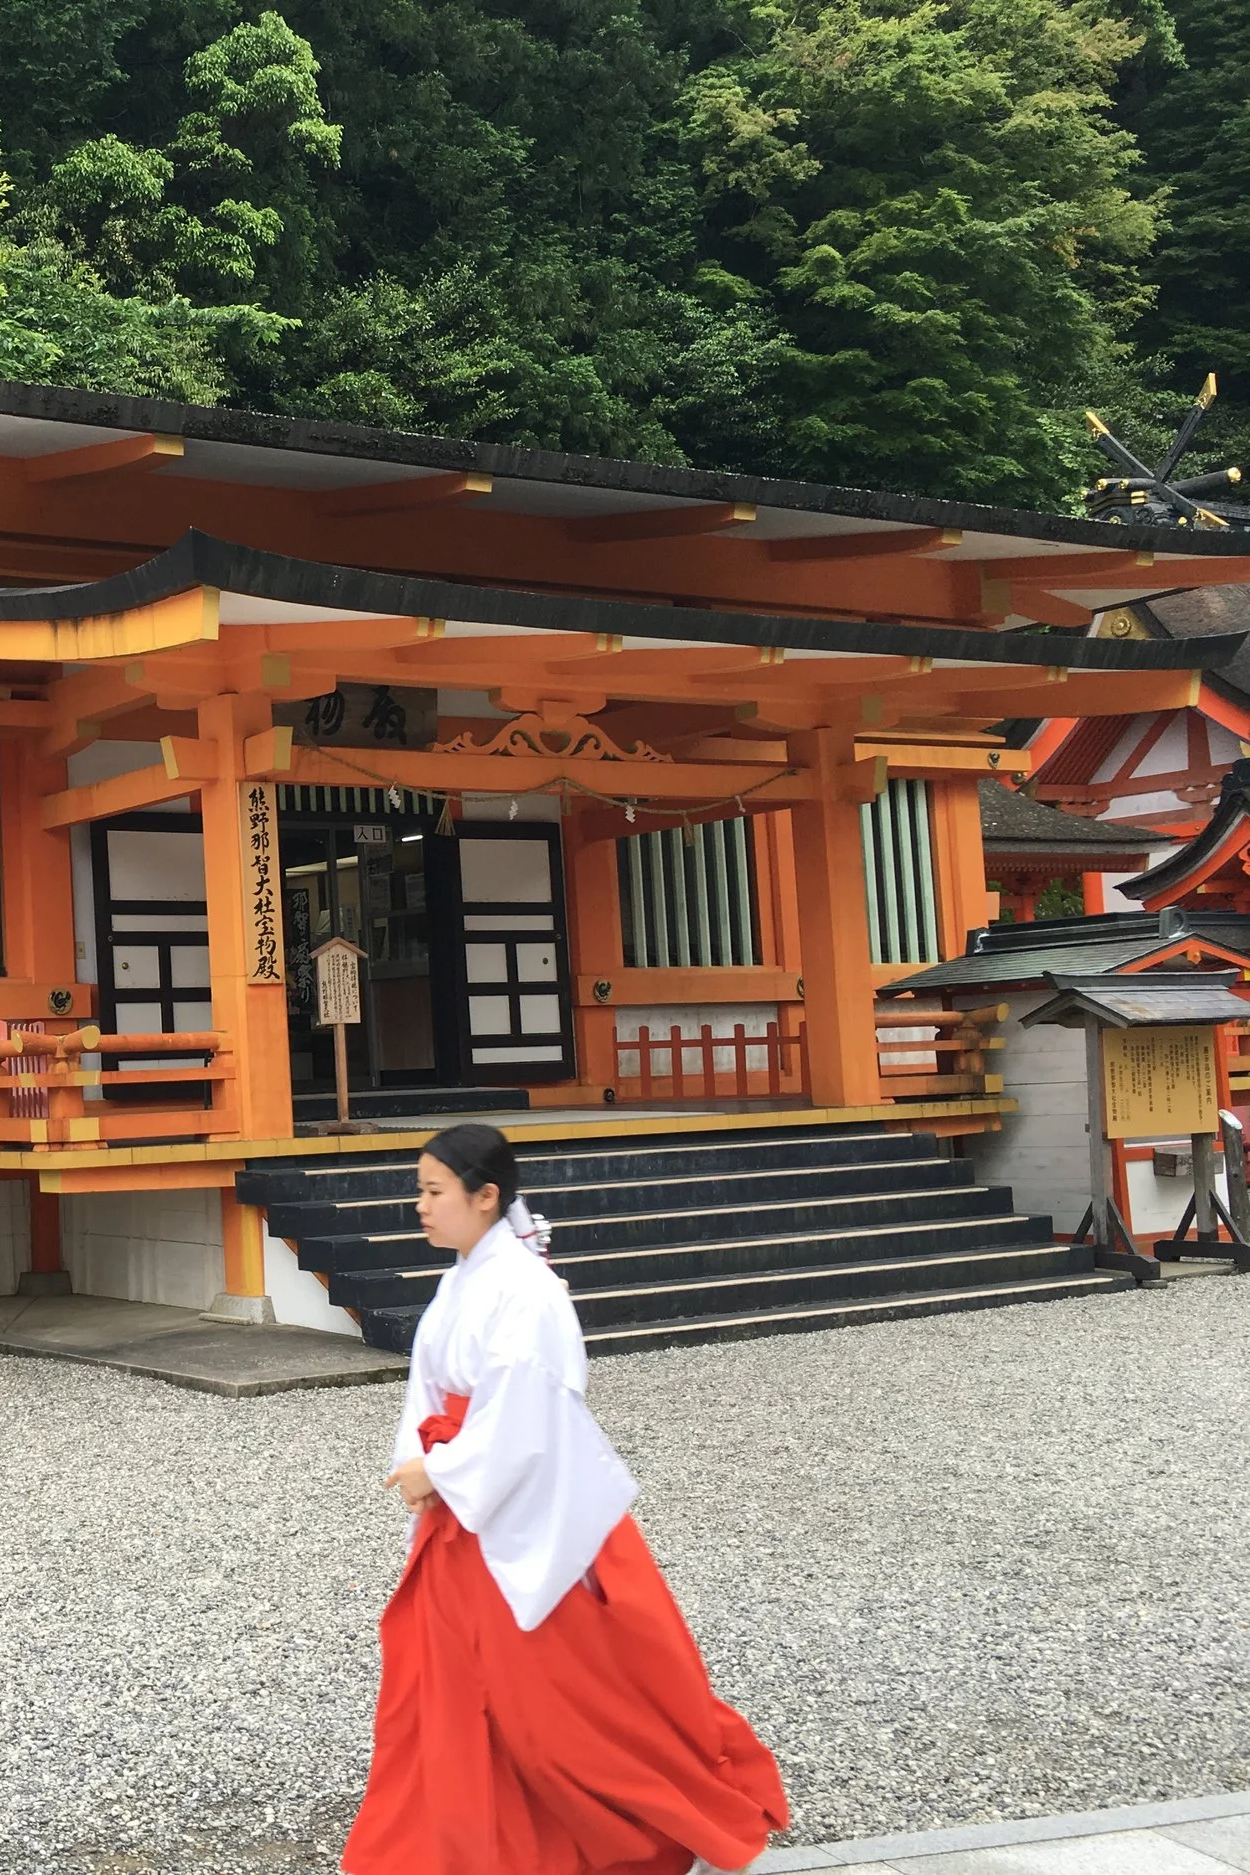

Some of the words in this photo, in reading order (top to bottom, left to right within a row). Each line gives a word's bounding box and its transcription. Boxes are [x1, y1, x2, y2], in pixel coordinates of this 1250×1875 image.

[248, 786, 281, 980] 熊野那智大社宝物殿
[357, 826, 384, 842] 入口
